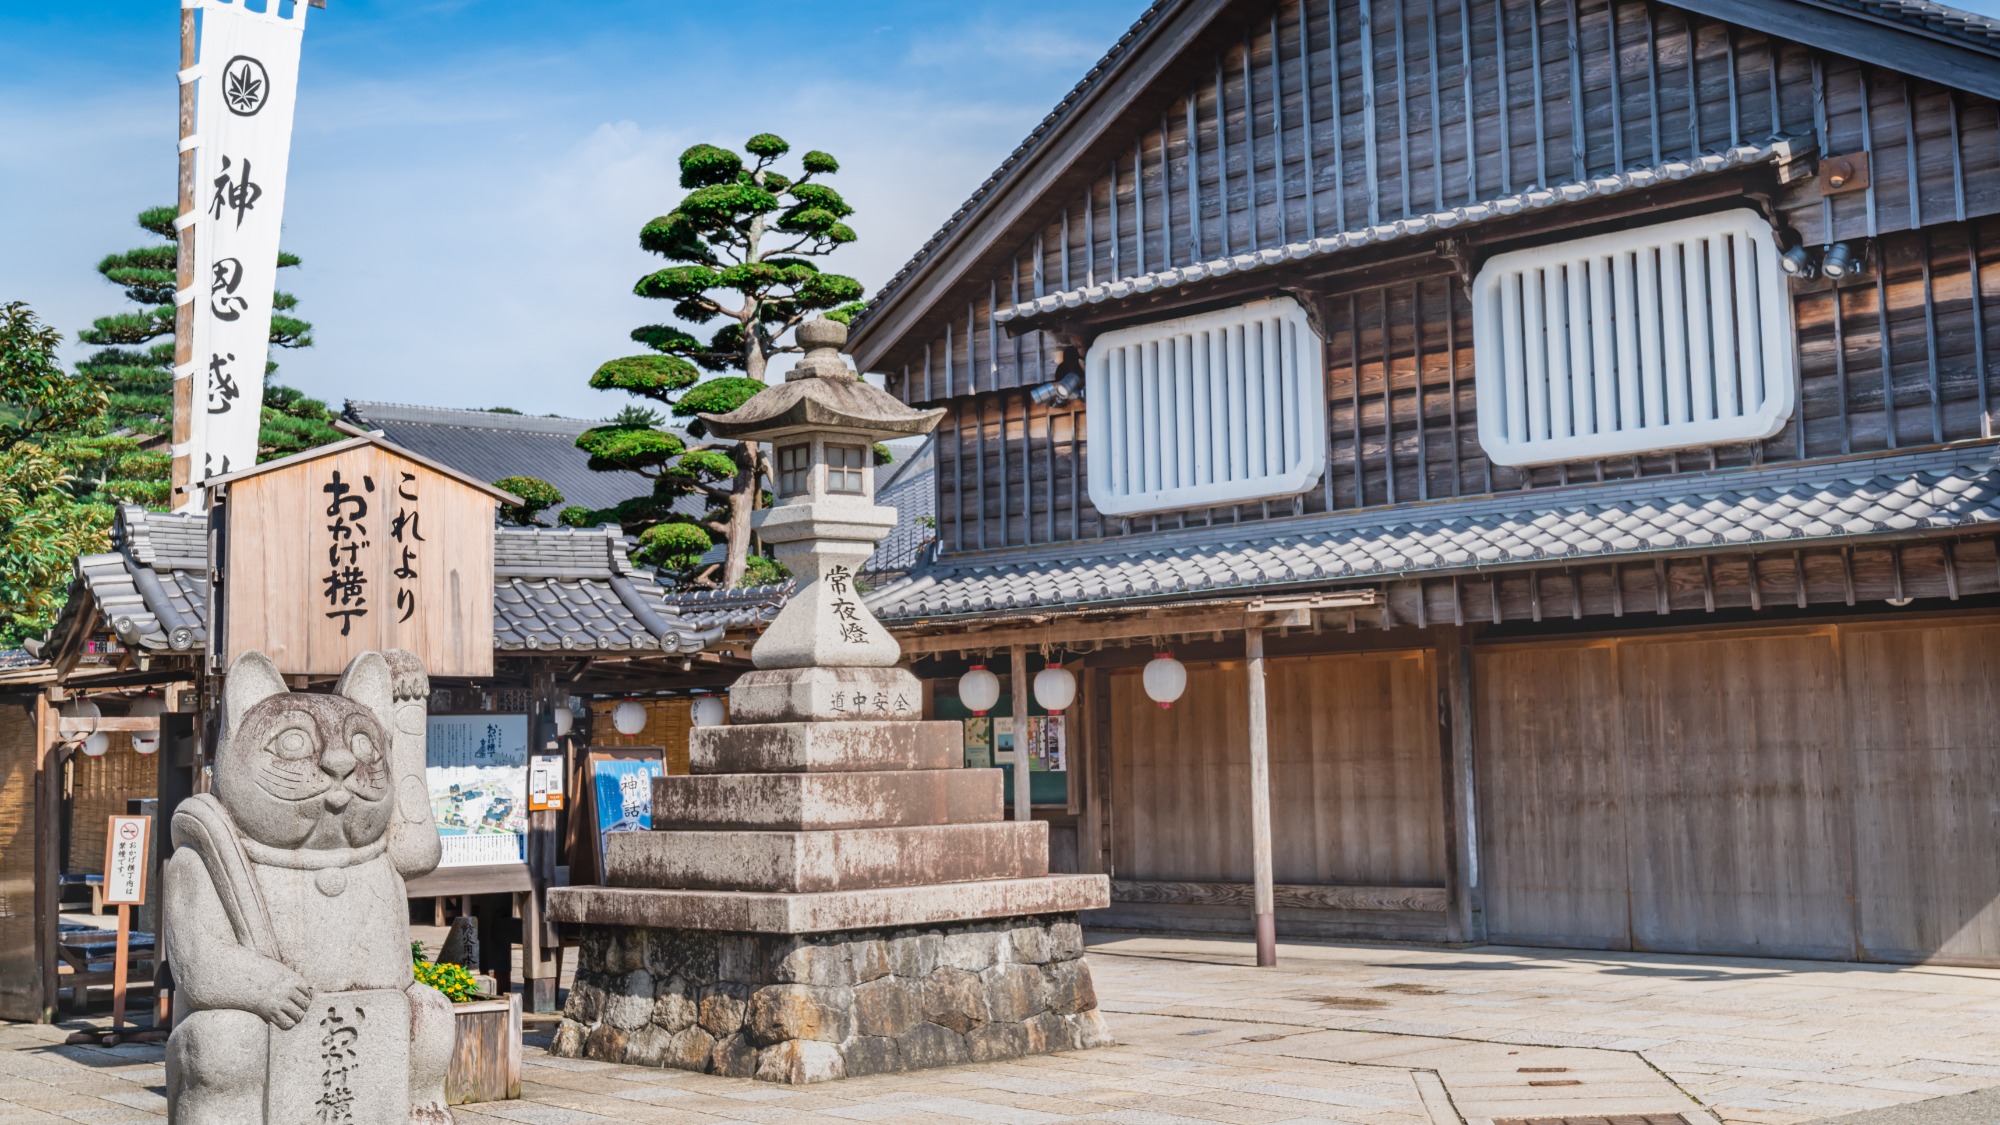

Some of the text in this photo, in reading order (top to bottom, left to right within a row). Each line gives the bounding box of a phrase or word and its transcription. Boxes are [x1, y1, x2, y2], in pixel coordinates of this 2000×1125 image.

[205, 153, 262, 479] 神恩感
[323, 470, 375, 636] おかげ横丁
[391, 471, 425, 624] これより
[825, 565, 869, 644] 常夜燈
[830, 691, 911, 713] 道中安全
[487, 723, 498, 758] おかげ横丁
[620, 775, 641, 831] 神話の
[125, 841, 137, 895] おかげ横丁内は
[461, 923, 478, 966] 防火用水
[315, 1006, 365, 1125] おかげ横
